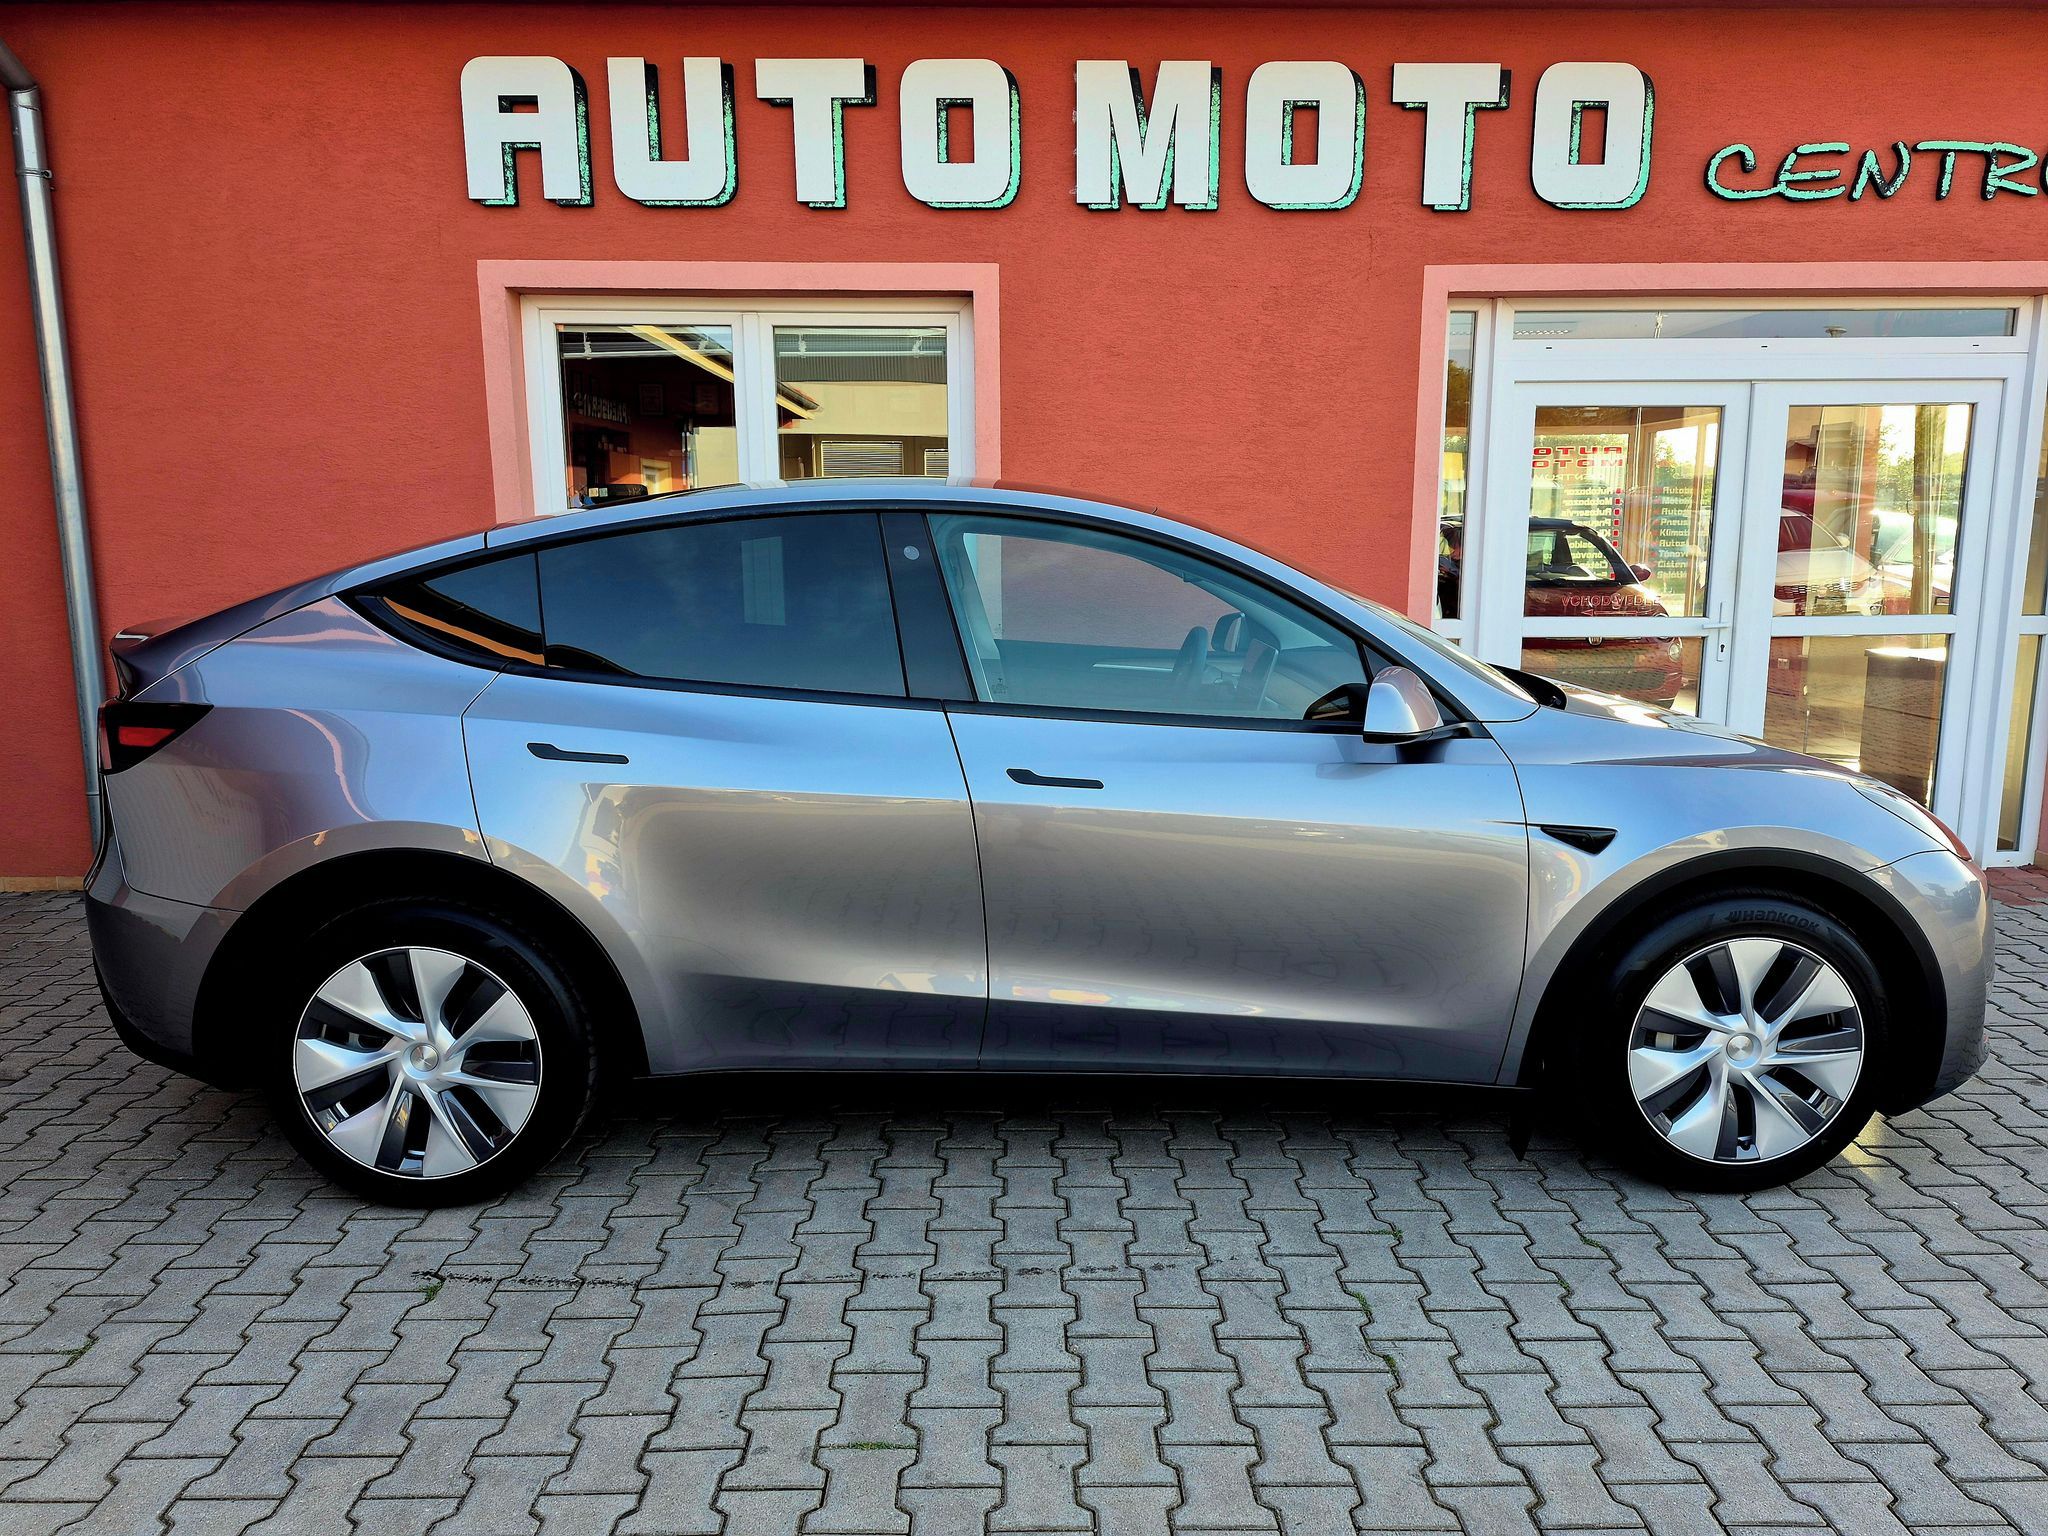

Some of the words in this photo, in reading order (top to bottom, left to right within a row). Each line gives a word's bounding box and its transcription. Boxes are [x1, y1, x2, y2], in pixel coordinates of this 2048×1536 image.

[460, 56, 1020, 209] AUTO
[1076, 60, 1654, 211] MOTO
[1704, 139, 2048, 202] CENTR
[1561, 595, 1611, 607] VCHOD
